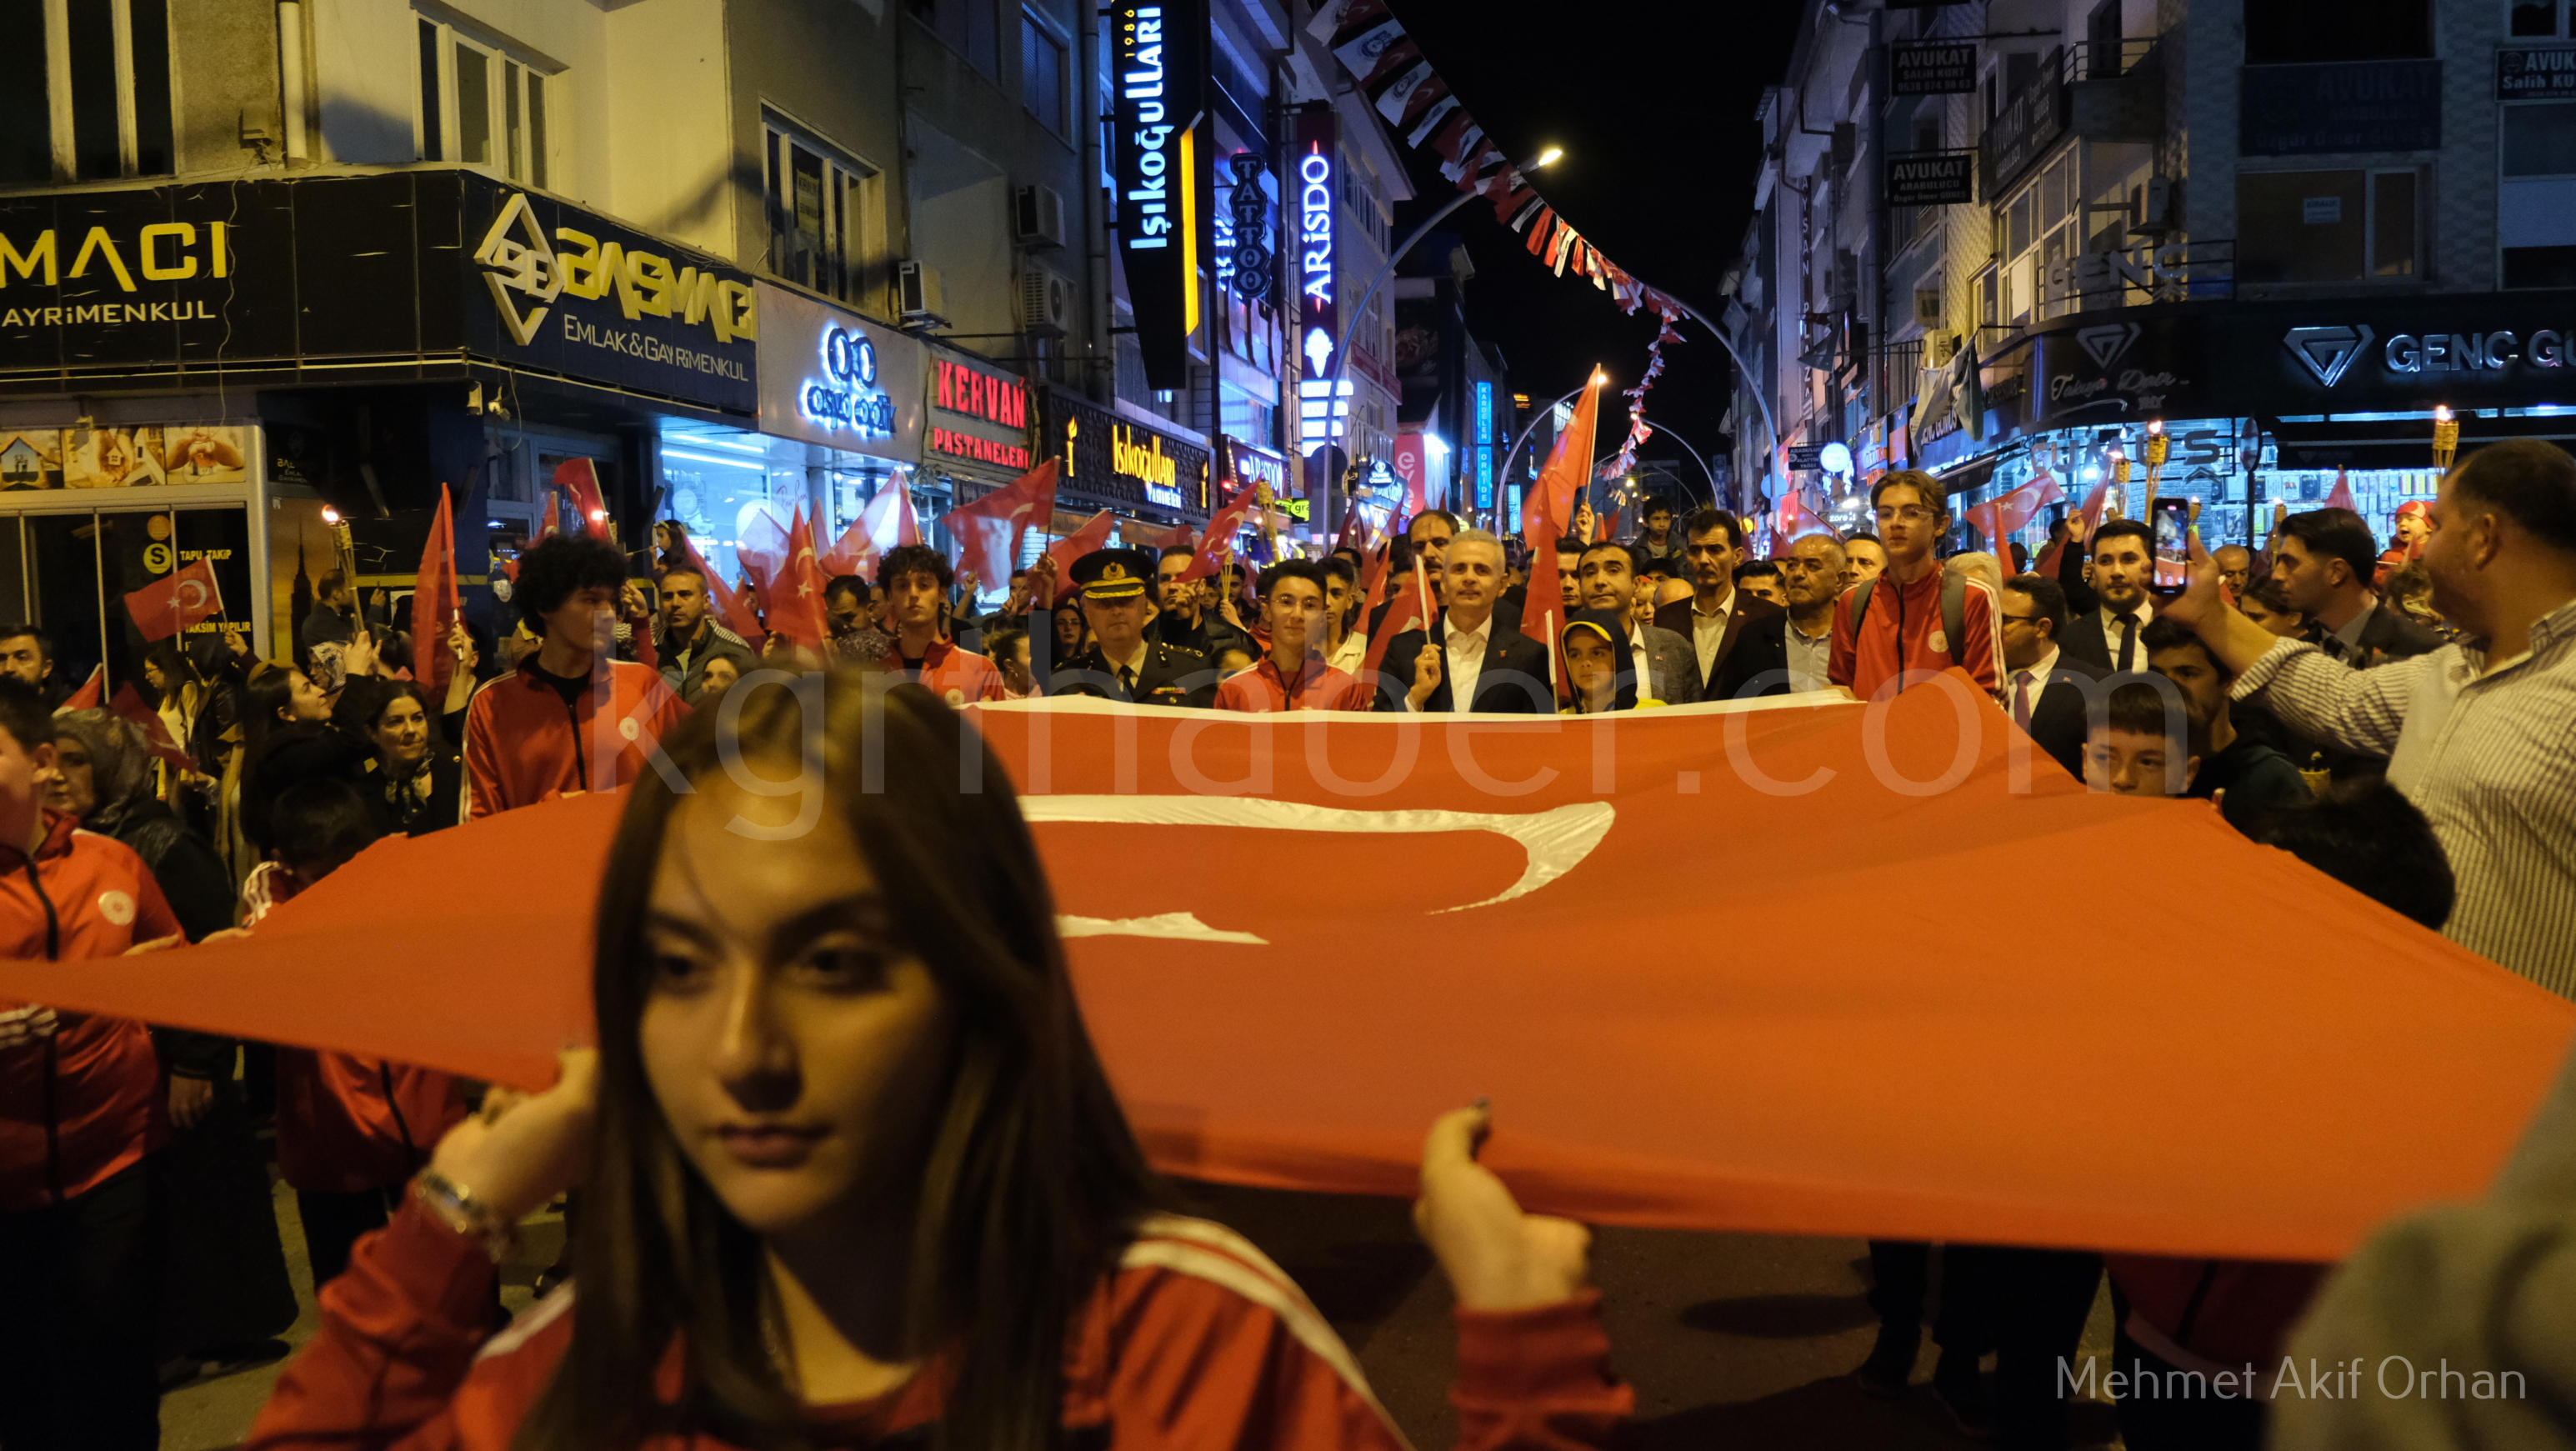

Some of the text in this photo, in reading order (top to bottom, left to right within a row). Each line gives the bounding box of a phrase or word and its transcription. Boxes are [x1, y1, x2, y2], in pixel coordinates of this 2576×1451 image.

[1125, 8, 1136, 58] 1986
[1898, 49, 1969, 68] AVUKAT
[1893, 161, 1965, 180] AVUKAT
[1238, 161, 1263, 290] TATTOO
[938, 359, 1025, 428] KERVAN
[180, 550, 203, 561] TAPU
